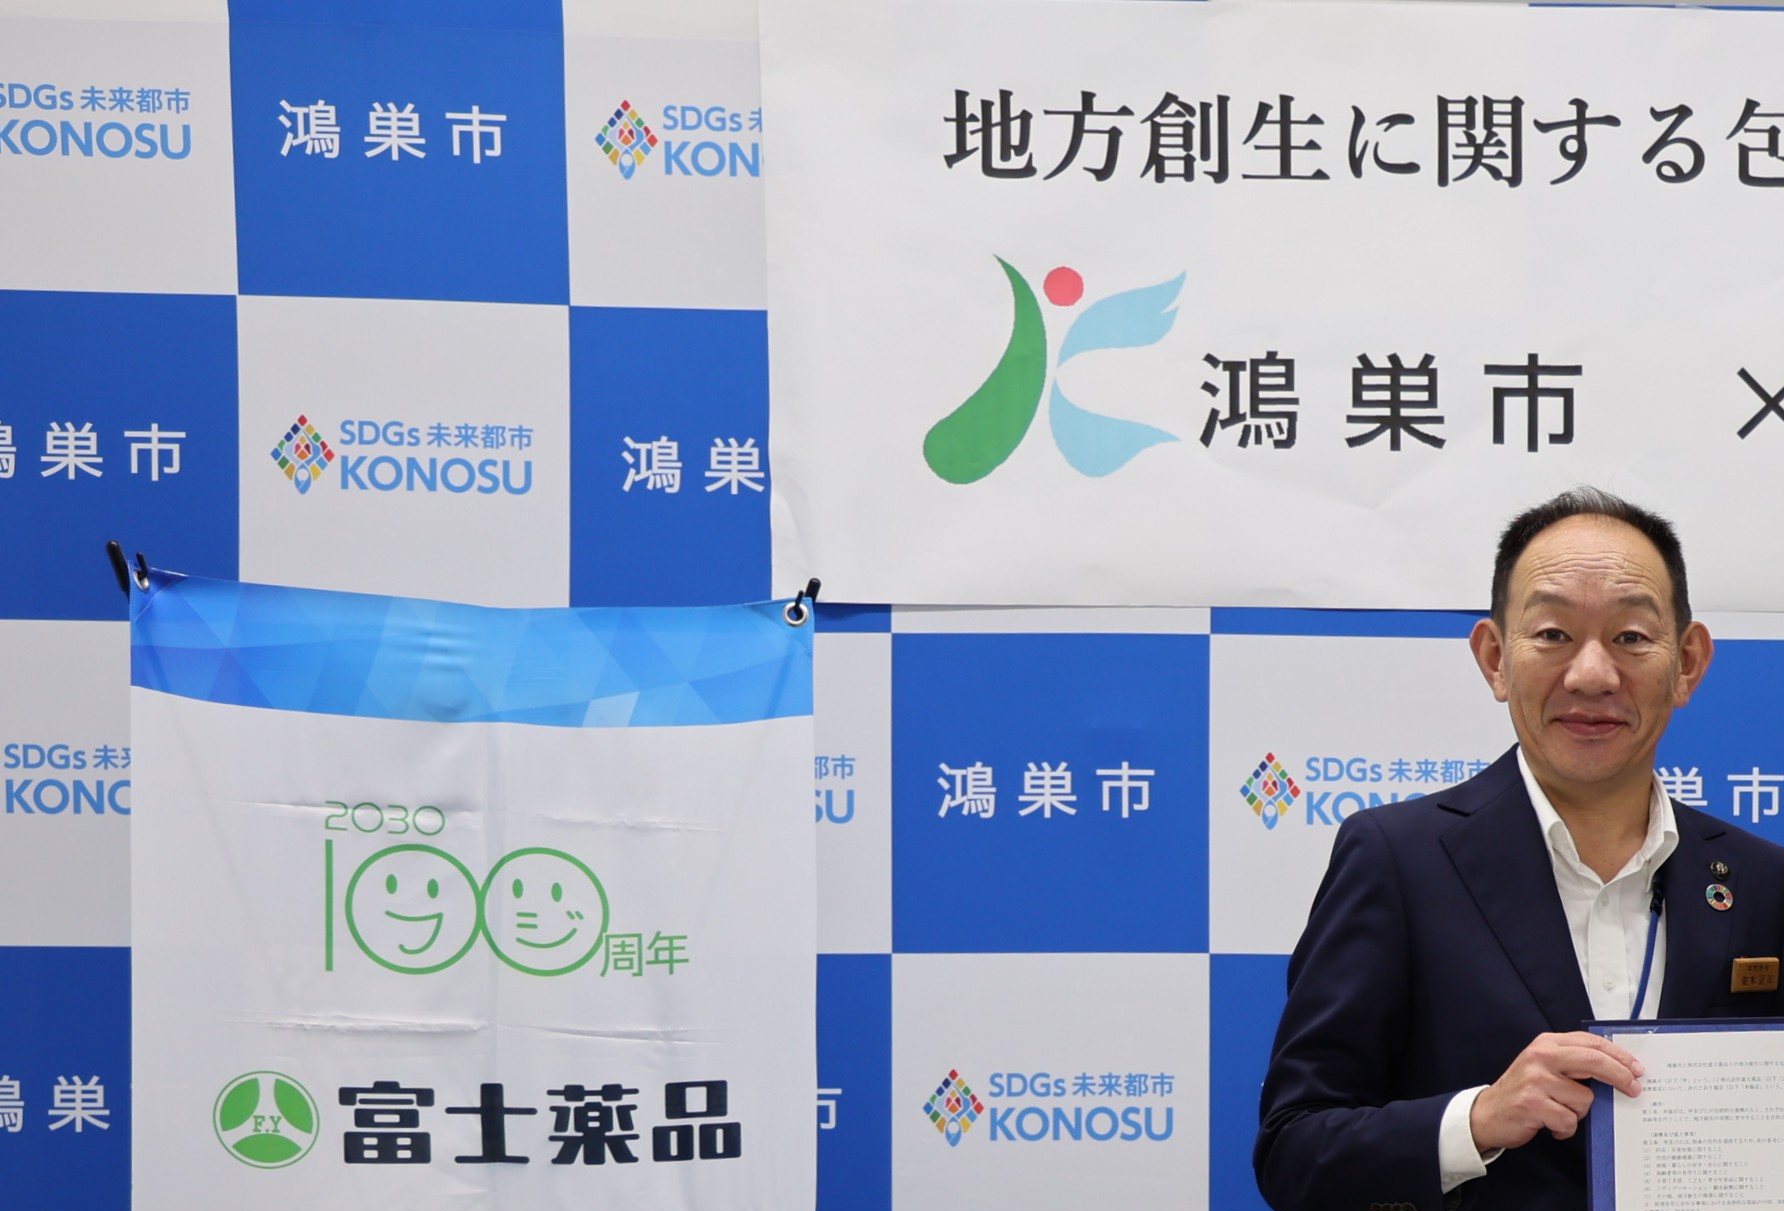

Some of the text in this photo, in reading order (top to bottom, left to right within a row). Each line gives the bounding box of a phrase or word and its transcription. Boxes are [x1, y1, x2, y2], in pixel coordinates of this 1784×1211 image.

[82, 88, 189, 112] 未来都市
[664, 105, 742, 131] SDGs
[0, 120, 191, 159] KONOSU
[279, 100, 507, 164] 鴻巣市
[1201, 352, 1582, 452] 鴻巣市
[0, 422, 186, 481] 巣市
[341, 420, 531, 448] SDGs 未来都市
[341, 456, 532, 495] KONOSU
[4, 743, 87, 769] SDGs
[1307, 757, 1382, 782] SDGs
[938, 762, 1155, 818] 鴻巣市
[325, 801, 446, 837] 2030
[990, 1072, 1172, 1097] SDGs 未来都市
[339, 1081, 741, 1165] 富士薬品
[990, 1107, 1173, 1141] KONOSU
